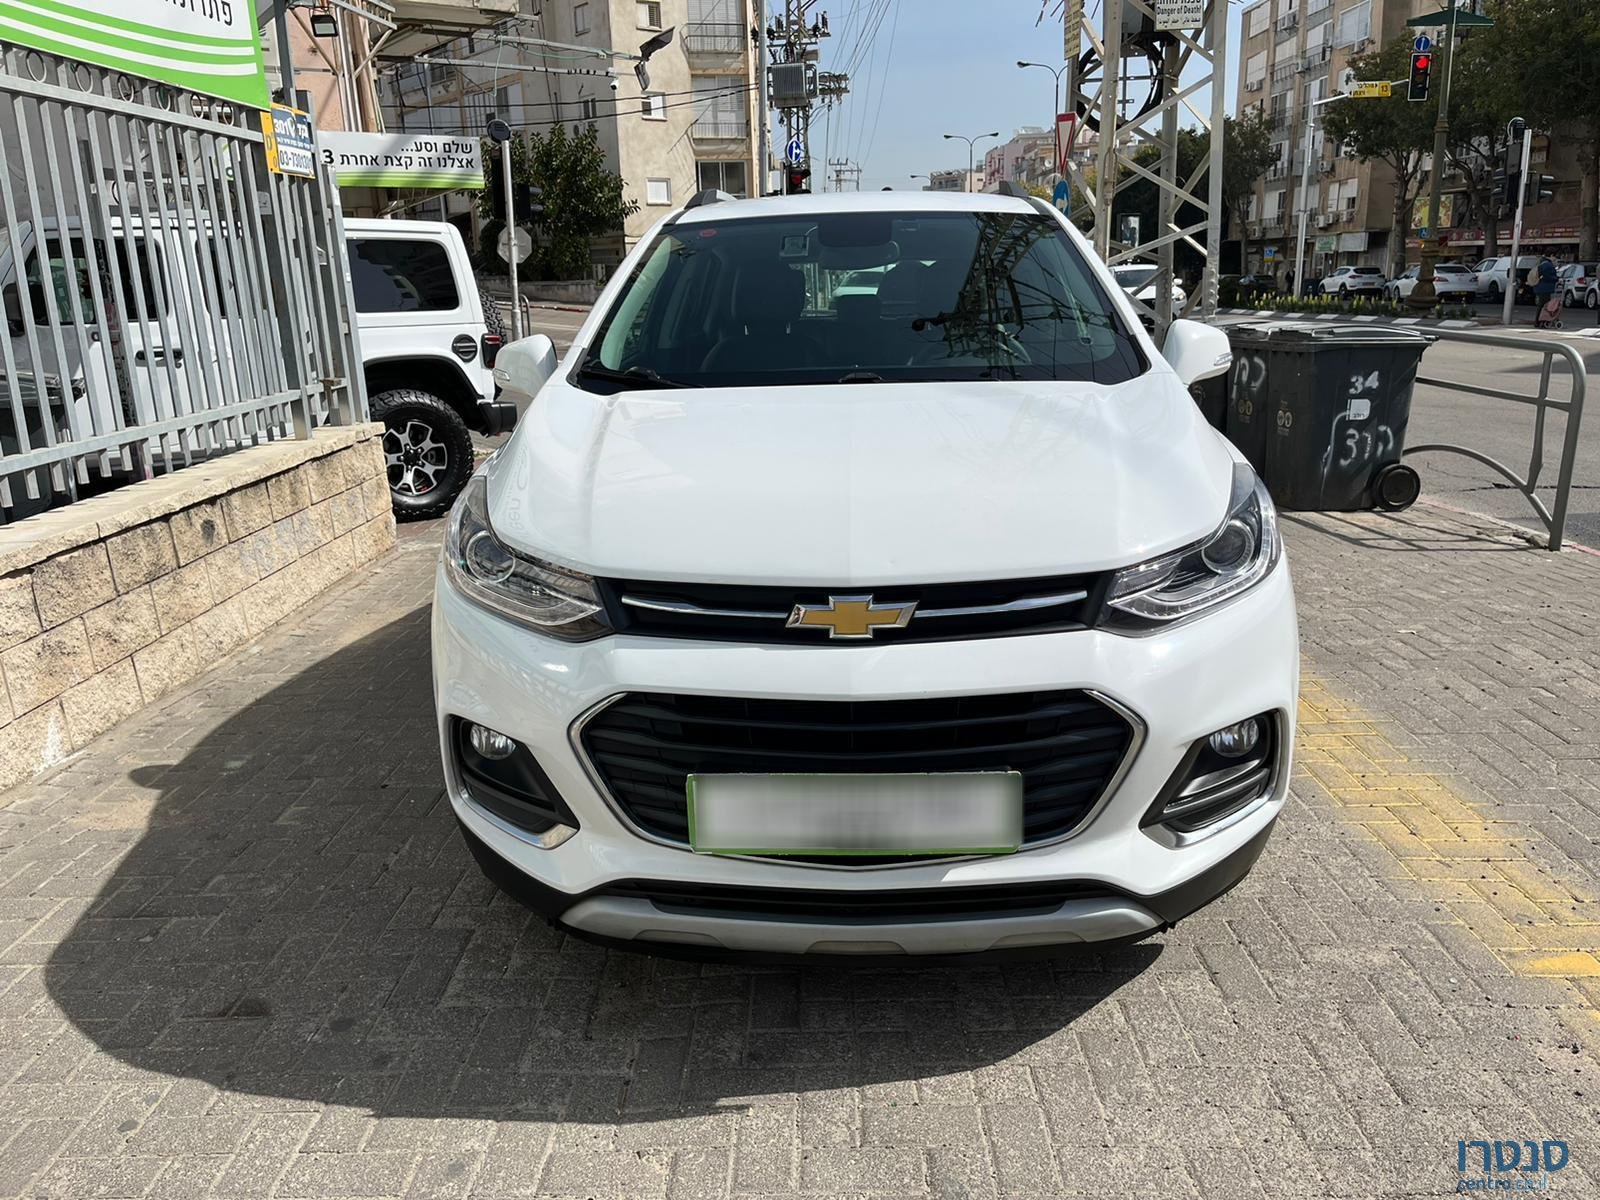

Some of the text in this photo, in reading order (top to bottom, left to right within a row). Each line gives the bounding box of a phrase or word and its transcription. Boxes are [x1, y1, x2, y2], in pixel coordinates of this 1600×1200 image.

[1157, 5, 1202, 16] Danger of Death!
[401, 140, 473, 154] שלם וסע...
[339, 153, 475, 170] אצלנו זה קצת אחרת
[1348, 370, 1379, 395] 34
